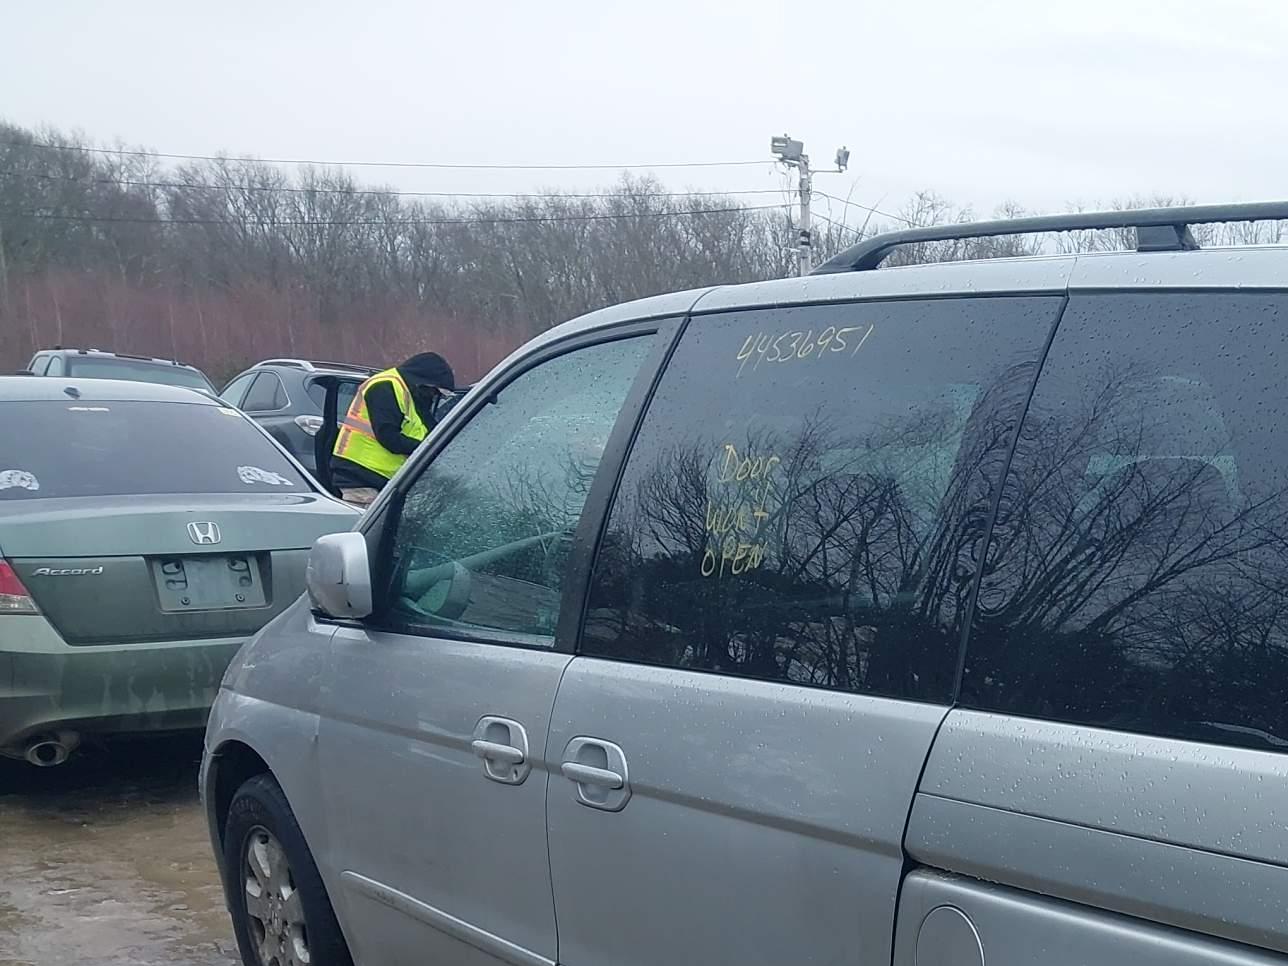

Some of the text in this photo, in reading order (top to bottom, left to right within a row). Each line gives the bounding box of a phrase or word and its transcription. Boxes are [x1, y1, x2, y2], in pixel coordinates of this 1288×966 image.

[735, 323, 874, 378] 44536951
[718, 443, 781, 482] Door
[31, 566, 104, 577] Accord
